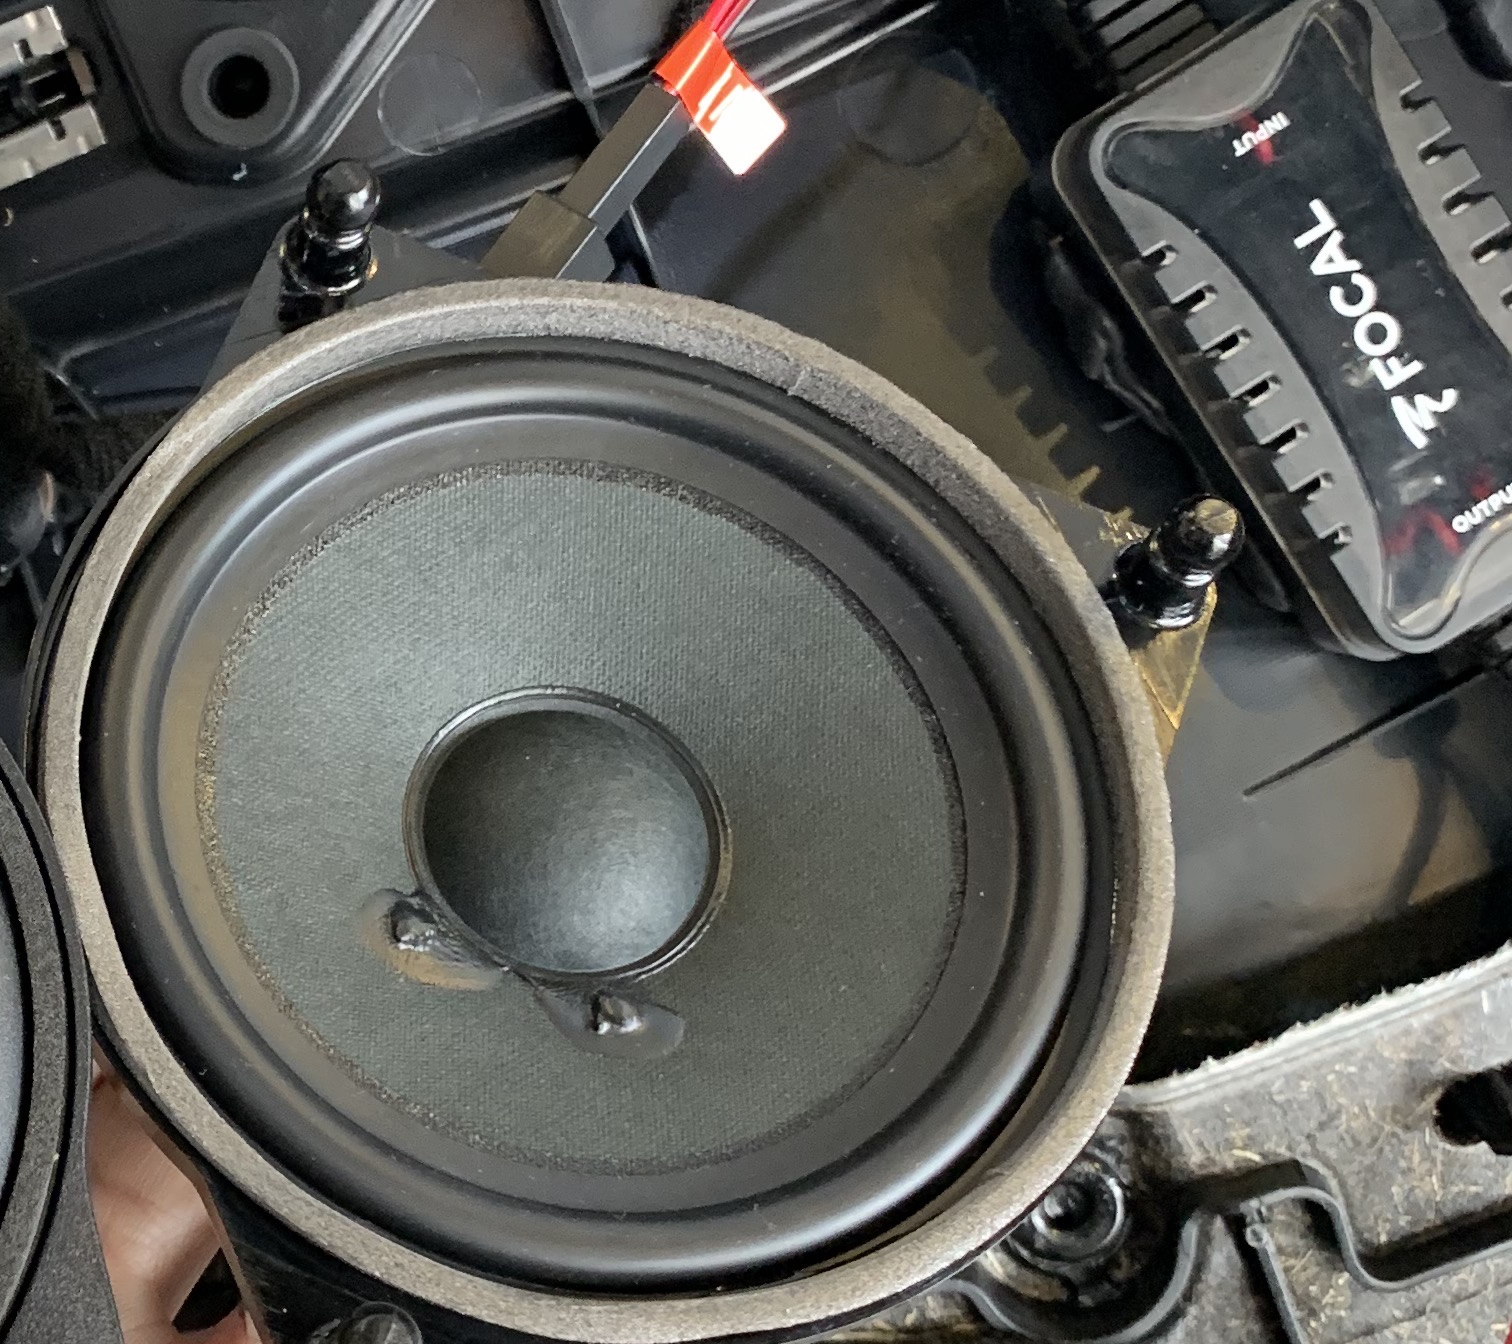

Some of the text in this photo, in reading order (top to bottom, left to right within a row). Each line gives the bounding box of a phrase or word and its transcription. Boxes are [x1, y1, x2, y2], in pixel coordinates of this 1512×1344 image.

[1232, 111, 1291, 157] INPUT
[1293, 198, 1426, 391] FOCAL
[1451, 482, 1512, 533] OUTPU
